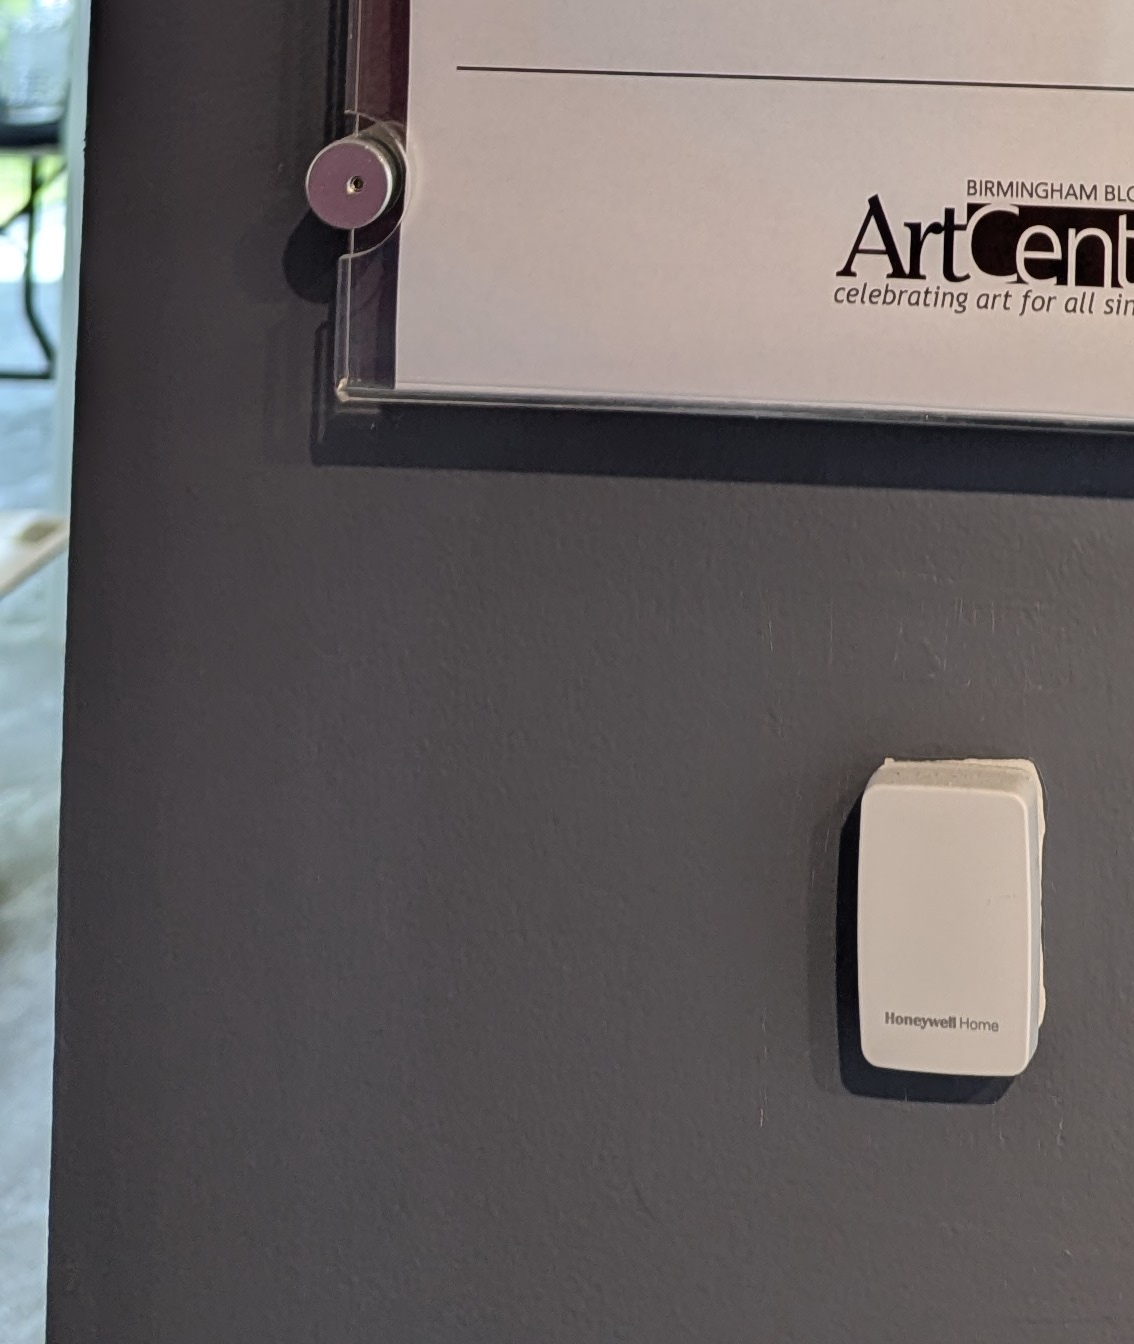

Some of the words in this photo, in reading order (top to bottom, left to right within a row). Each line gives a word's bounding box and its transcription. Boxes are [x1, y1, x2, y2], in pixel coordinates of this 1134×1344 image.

[966, 179, 1098, 201] BIRMINGHAM
[833, 282, 968, 314] celebrating
[976, 289, 1013, 311] art
[1018, 288, 1057, 316] for
[1064, 291, 1095, 315] all
[884, 1011, 957, 1030] Honeywell
[959, 1016, 1000, 1033] Home
